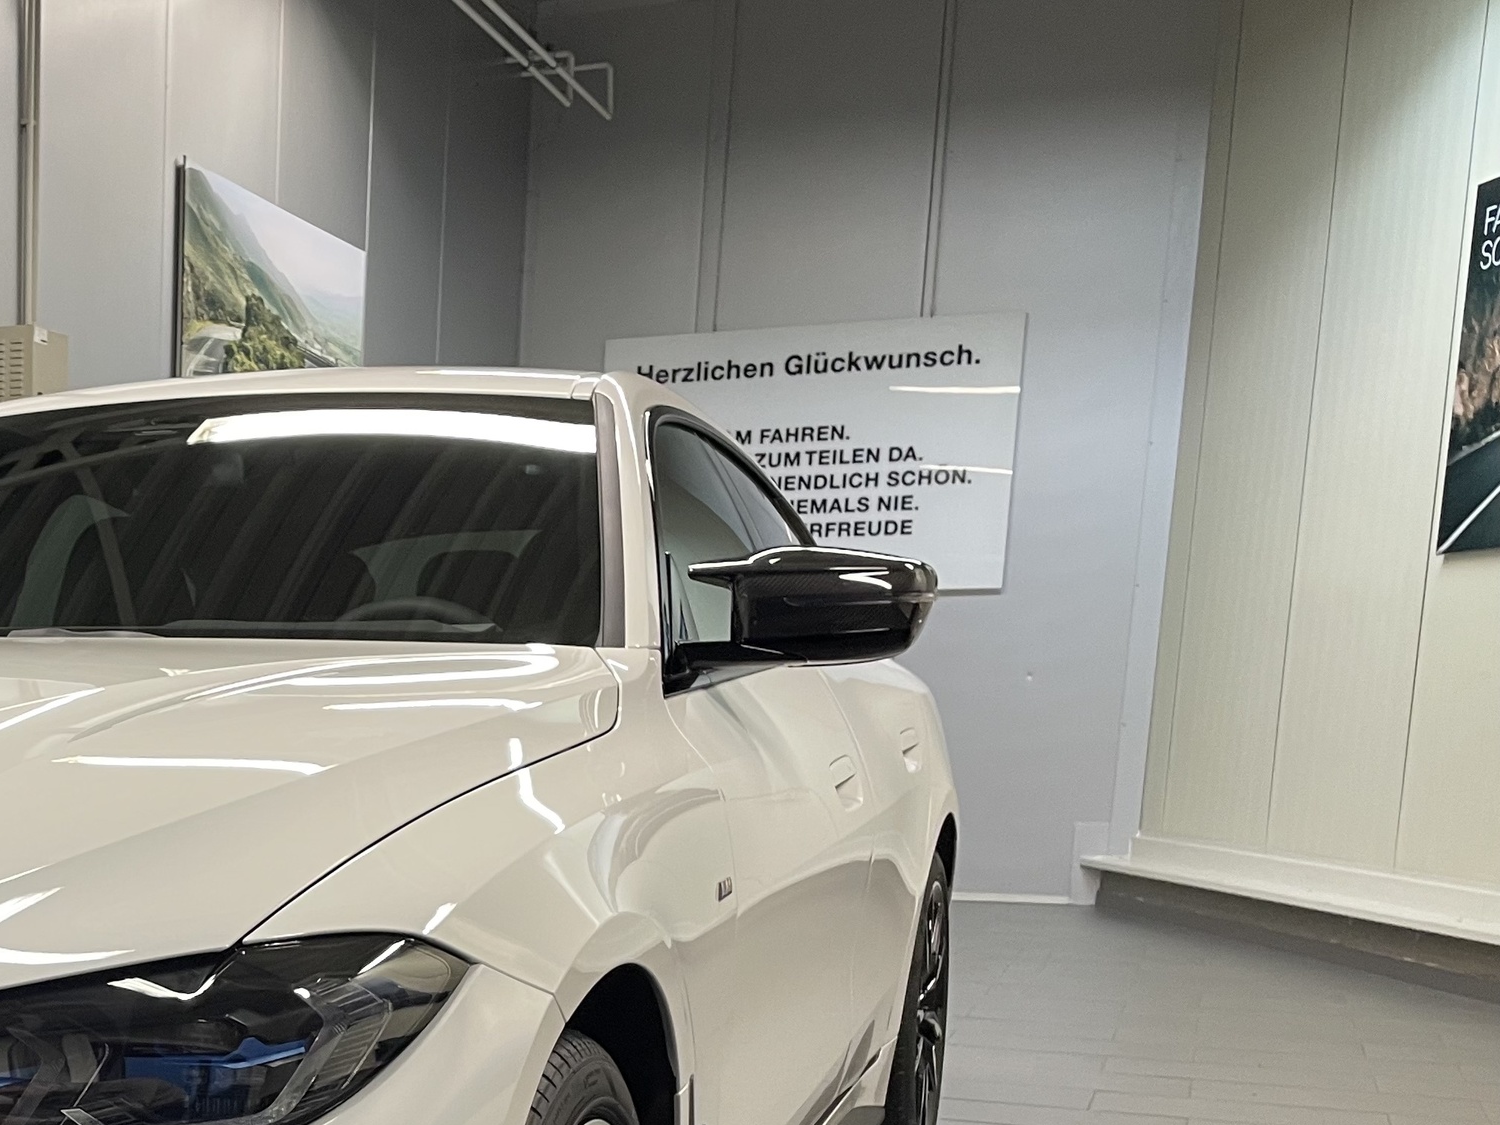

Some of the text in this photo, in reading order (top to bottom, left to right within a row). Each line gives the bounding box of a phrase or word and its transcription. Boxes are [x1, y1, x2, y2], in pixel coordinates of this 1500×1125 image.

[637, 344, 981, 384] Herzlichen Glückwunsch.
[760, 425, 850, 444] FAHREN.
[755, 445, 923, 468] ZUM TEILEN DA.
[878, 495, 919, 512] NIE.
